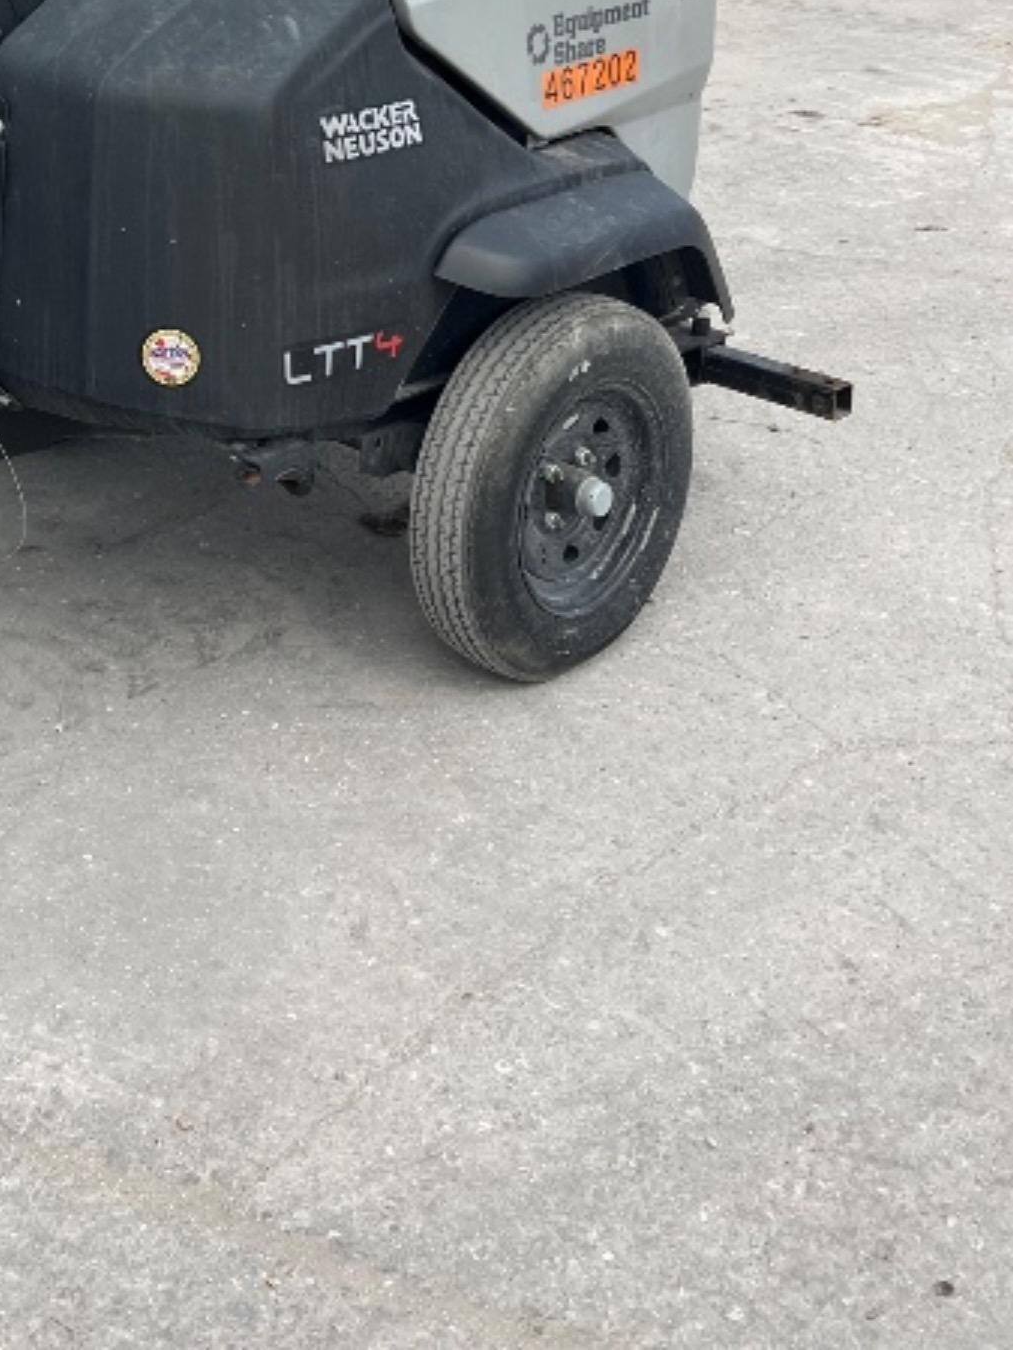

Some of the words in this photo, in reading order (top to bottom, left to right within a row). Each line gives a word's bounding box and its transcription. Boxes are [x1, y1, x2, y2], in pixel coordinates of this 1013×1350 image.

[553, 38, 606, 64] Share
[544, 49, 637, 102] 467202
[319, 98, 420, 140] WACKER
[322, 121, 423, 164] NEUSON
[283, 329, 404, 385] LTT4
